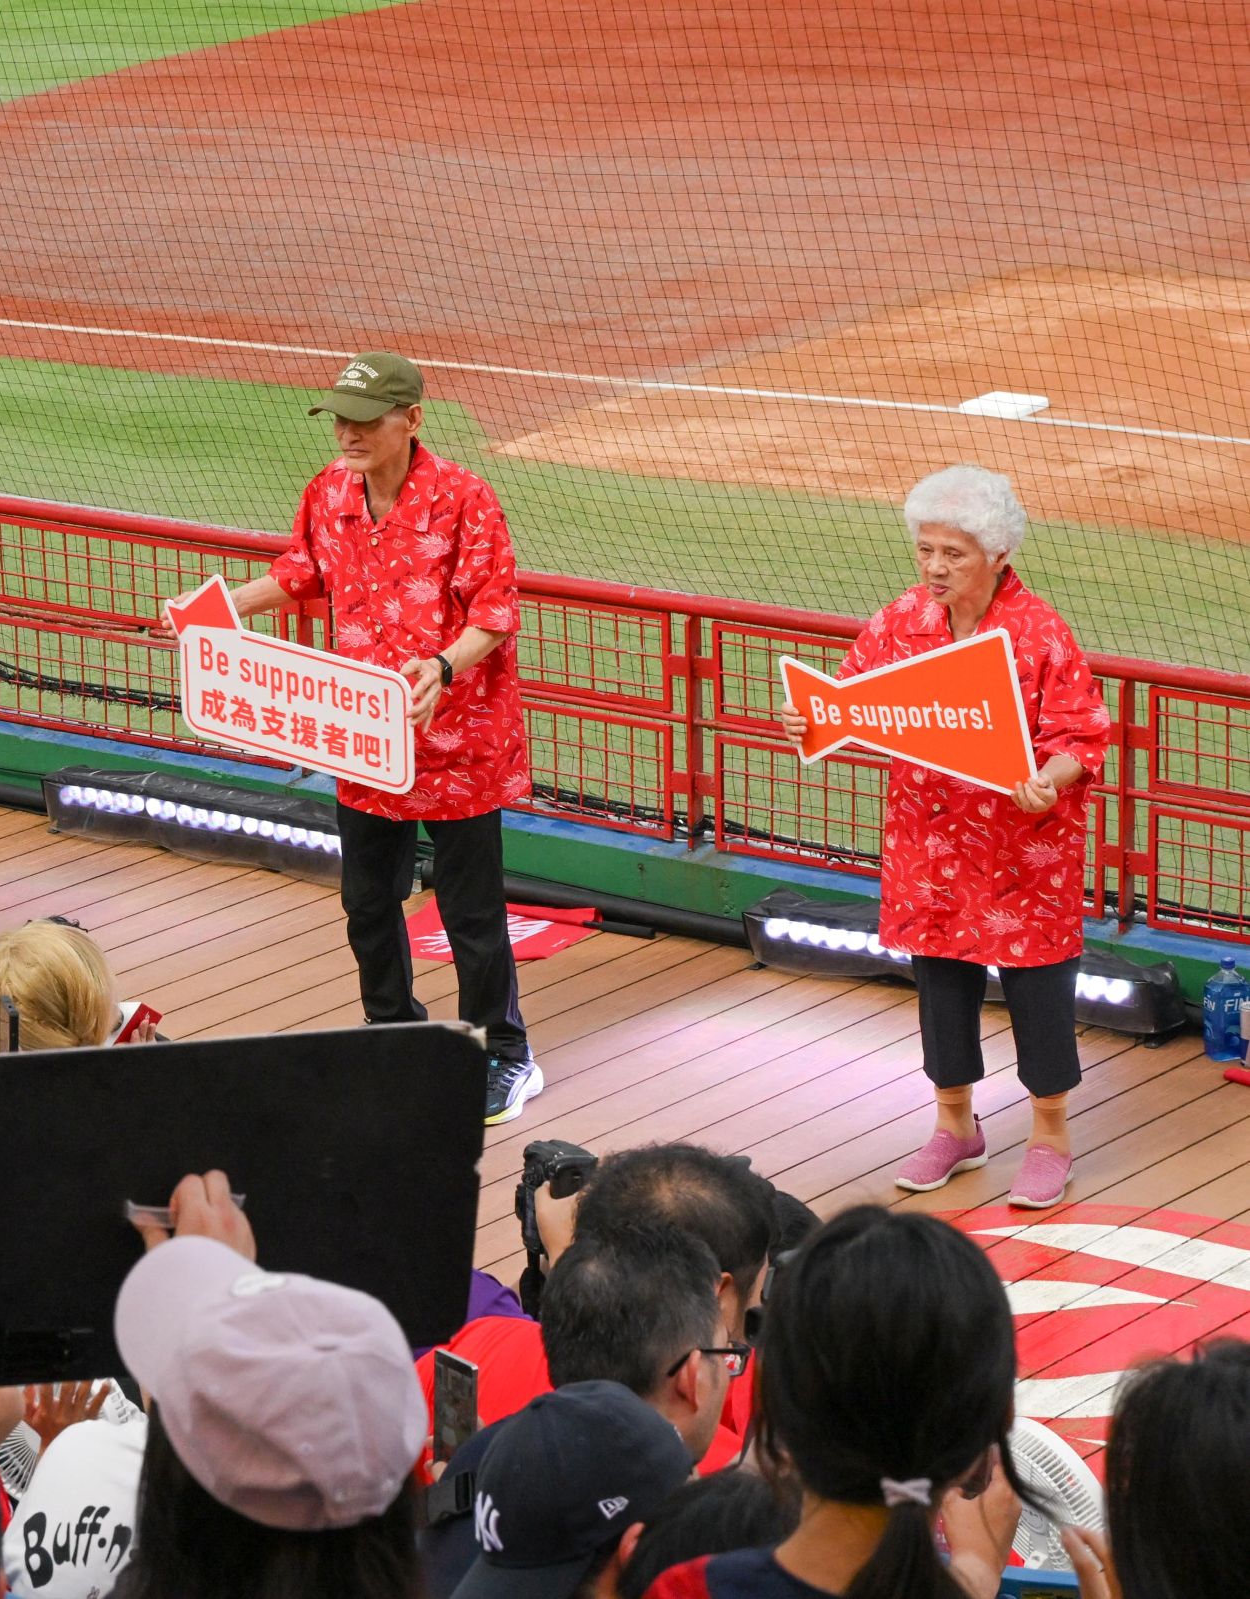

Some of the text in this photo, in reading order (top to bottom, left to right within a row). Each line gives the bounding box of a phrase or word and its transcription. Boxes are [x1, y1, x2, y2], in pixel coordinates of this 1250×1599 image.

[199, 637, 390, 723] Be supporters!
[809, 695, 993, 735] Be supporters!
[200, 688, 391, 773] 成為支援者吧!
